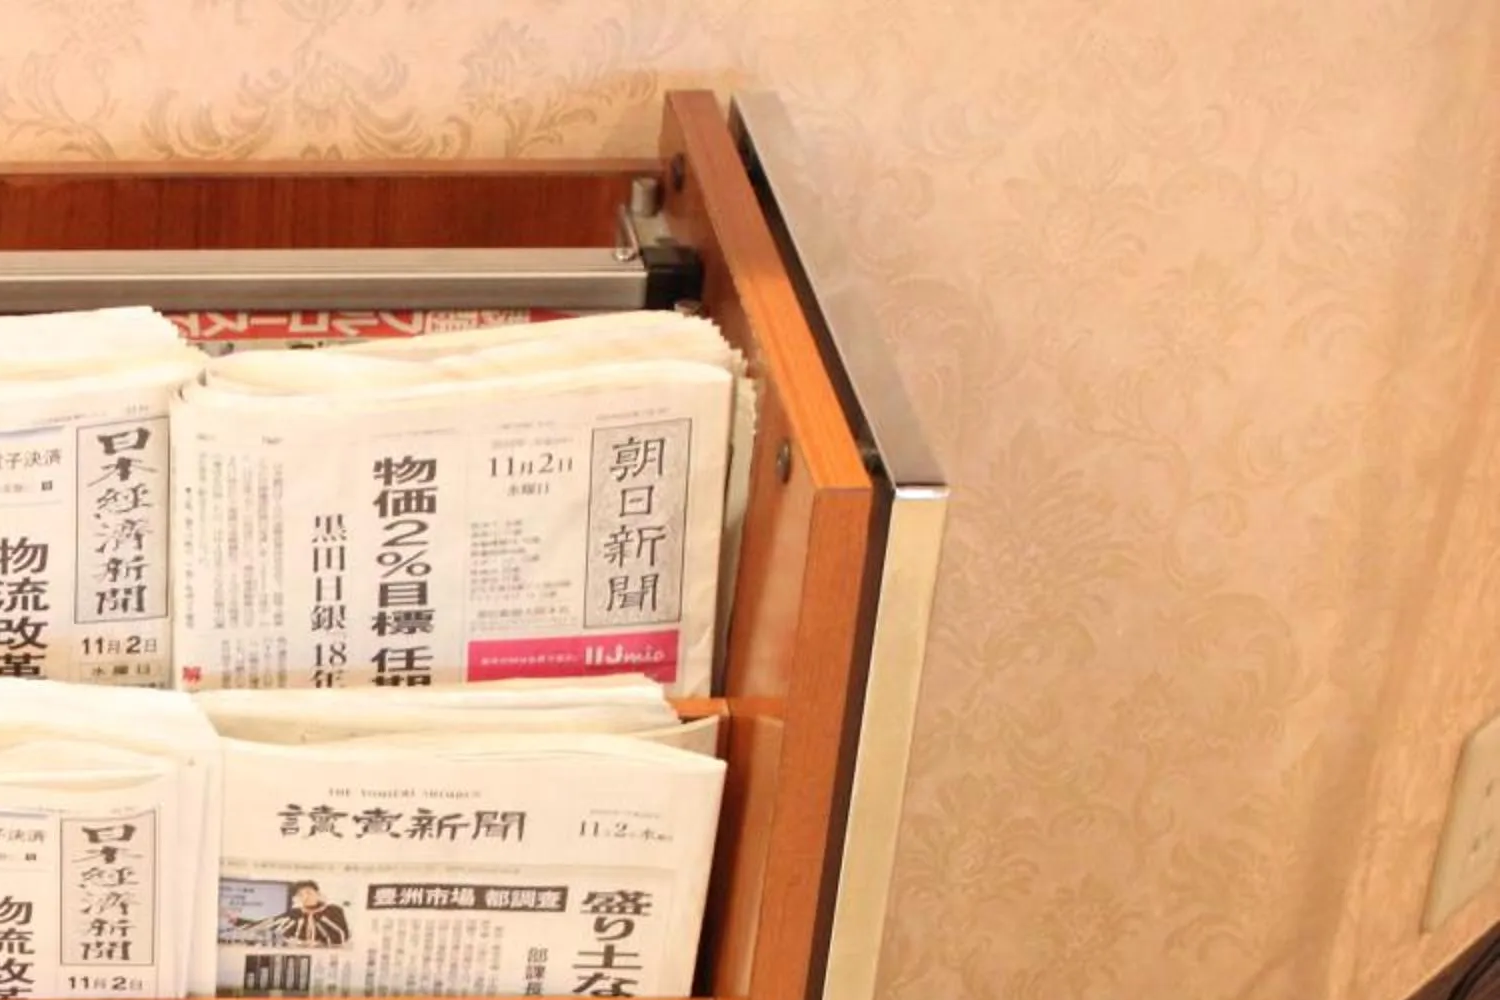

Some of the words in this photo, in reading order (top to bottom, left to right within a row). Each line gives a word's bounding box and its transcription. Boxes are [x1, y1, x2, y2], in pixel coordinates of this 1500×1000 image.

[603, 436, 667, 613] 朝日新聞
[81, 634, 158, 656] 11月2日
